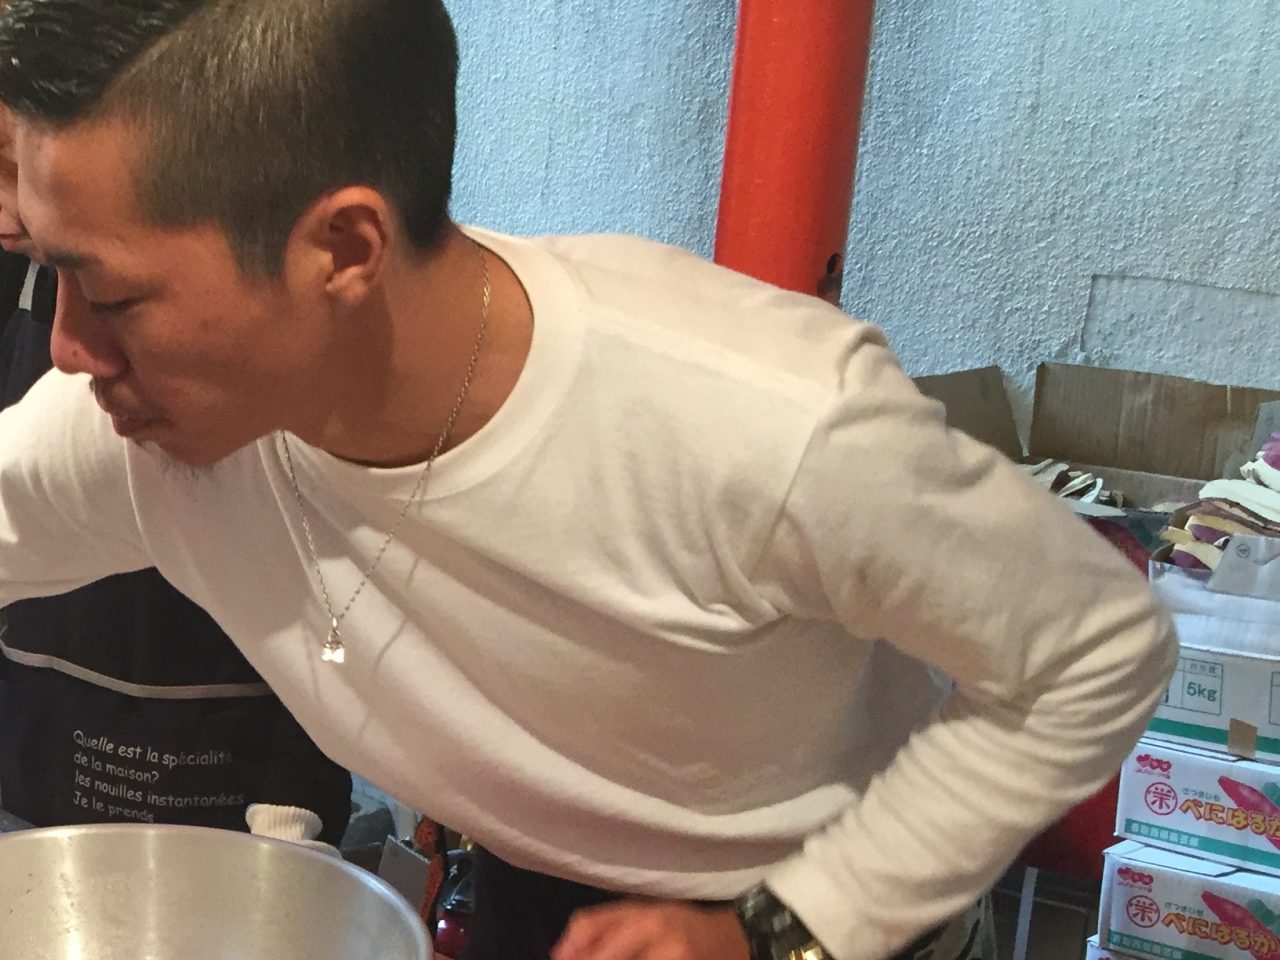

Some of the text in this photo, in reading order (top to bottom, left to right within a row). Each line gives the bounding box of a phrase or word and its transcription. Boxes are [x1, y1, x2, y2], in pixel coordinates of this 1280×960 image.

[1186, 681, 1217, 702] 5kg
[73, 730, 114, 754] Quelle
[118, 745, 143, 759] est
[146, 746, 159, 764] la
[73, 752, 160, 784] de la maison?
[75, 770, 245, 808] les nouilles instantanées
[72, 791, 154, 823] Je le prends
[1162, 912, 1279, 957] べにはるか
